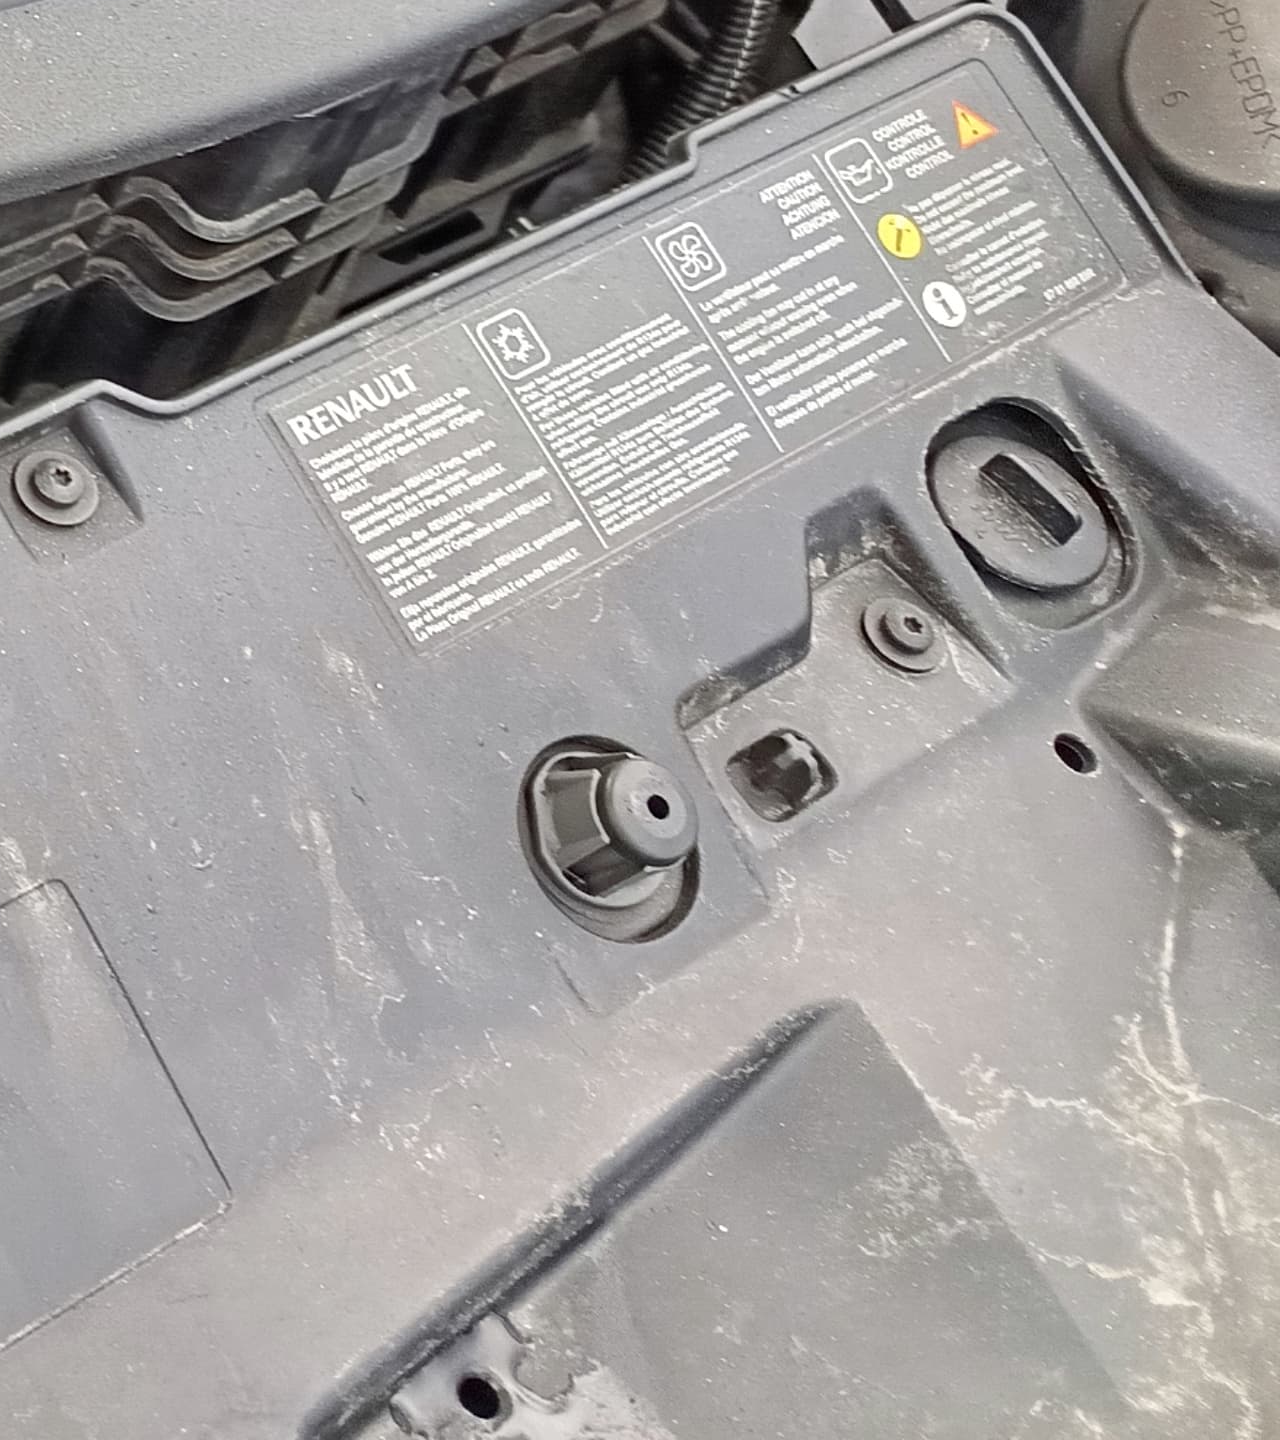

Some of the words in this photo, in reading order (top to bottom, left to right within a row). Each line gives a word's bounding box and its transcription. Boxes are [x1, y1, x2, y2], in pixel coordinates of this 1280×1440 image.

[871, 108, 927, 142] CONTROLE
[886, 121, 935, 152] CONTROL
[884, 134, 945, 172] KONTROLLE
[904, 147, 953, 179] CONTROL
[758, 168, 814, 203] ATTENTION
[777, 181, 823, 211] CAUTION
[781, 194, 831, 226] ACHTUNG
[287, 364, 419, 446] RENAULT
